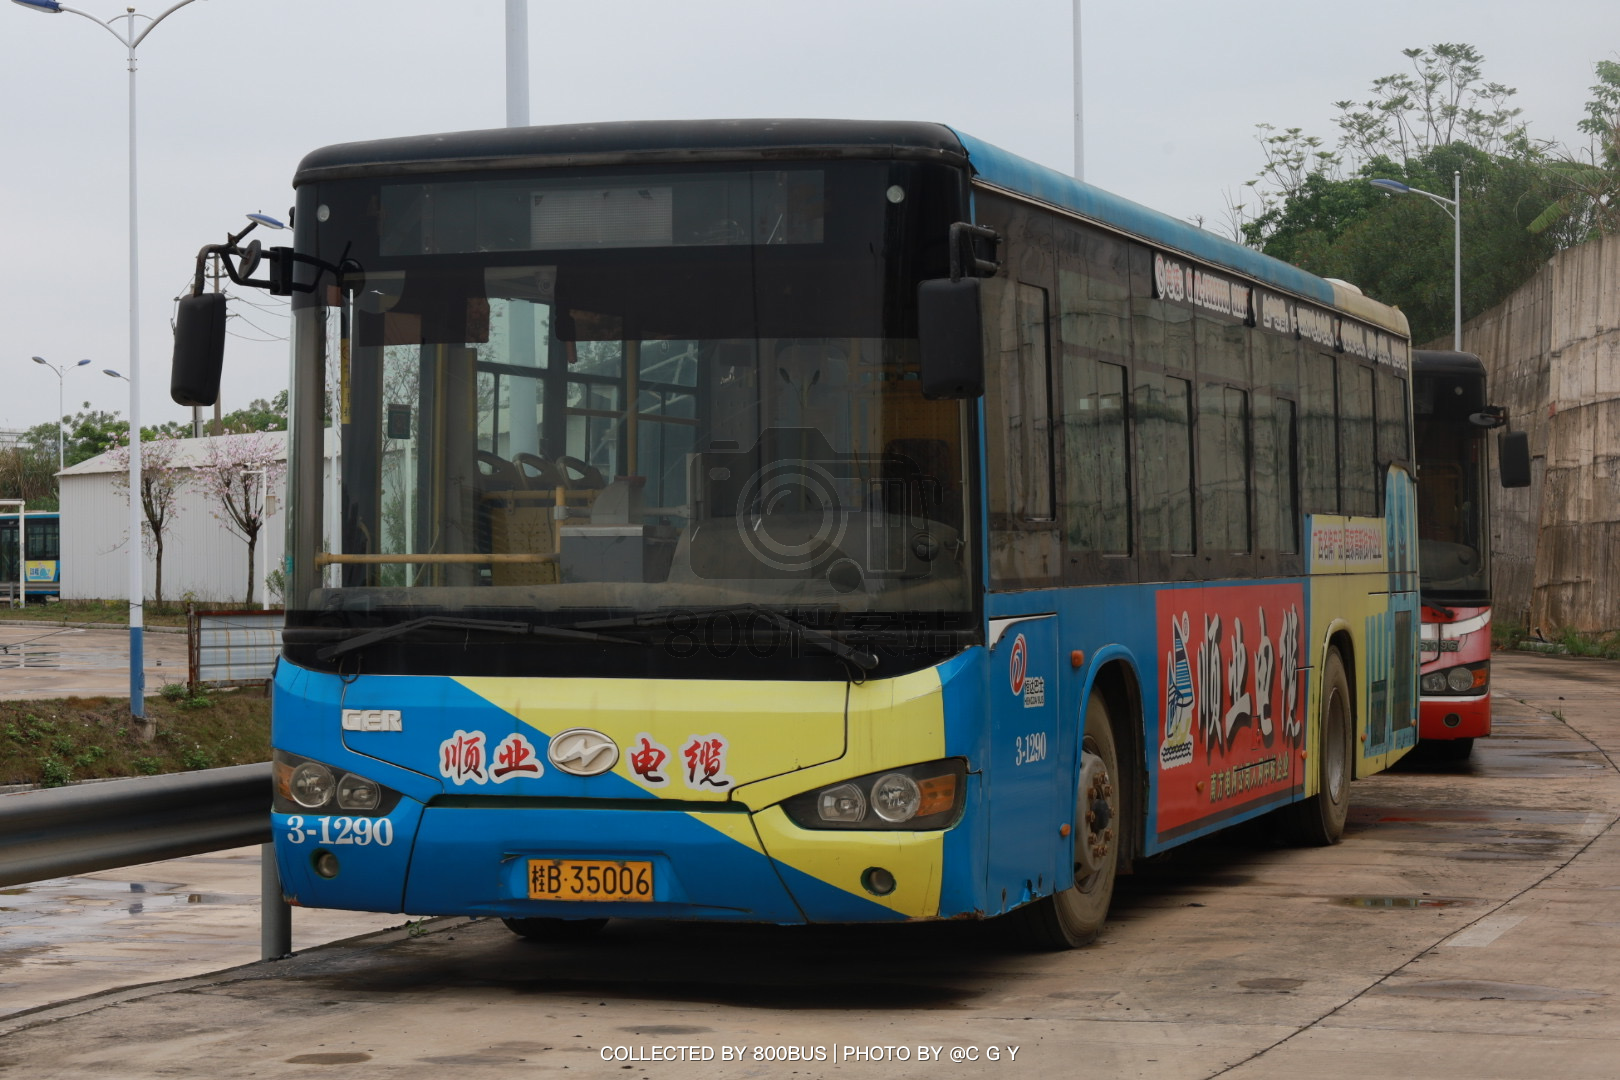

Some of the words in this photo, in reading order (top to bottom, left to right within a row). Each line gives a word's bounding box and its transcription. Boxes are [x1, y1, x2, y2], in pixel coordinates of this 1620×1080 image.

[1024, 679, 1044, 695] 恒达巴士
[1197, 602, 1301, 751] 顺业电缆
[341, 708, 403, 732] GER
[441, 731, 543, 784] 顺业
[627, 733, 733, 790] 电缆
[1015, 731, 1047, 766] 3-1290
[286, 815, 393, 846] 3-1290
